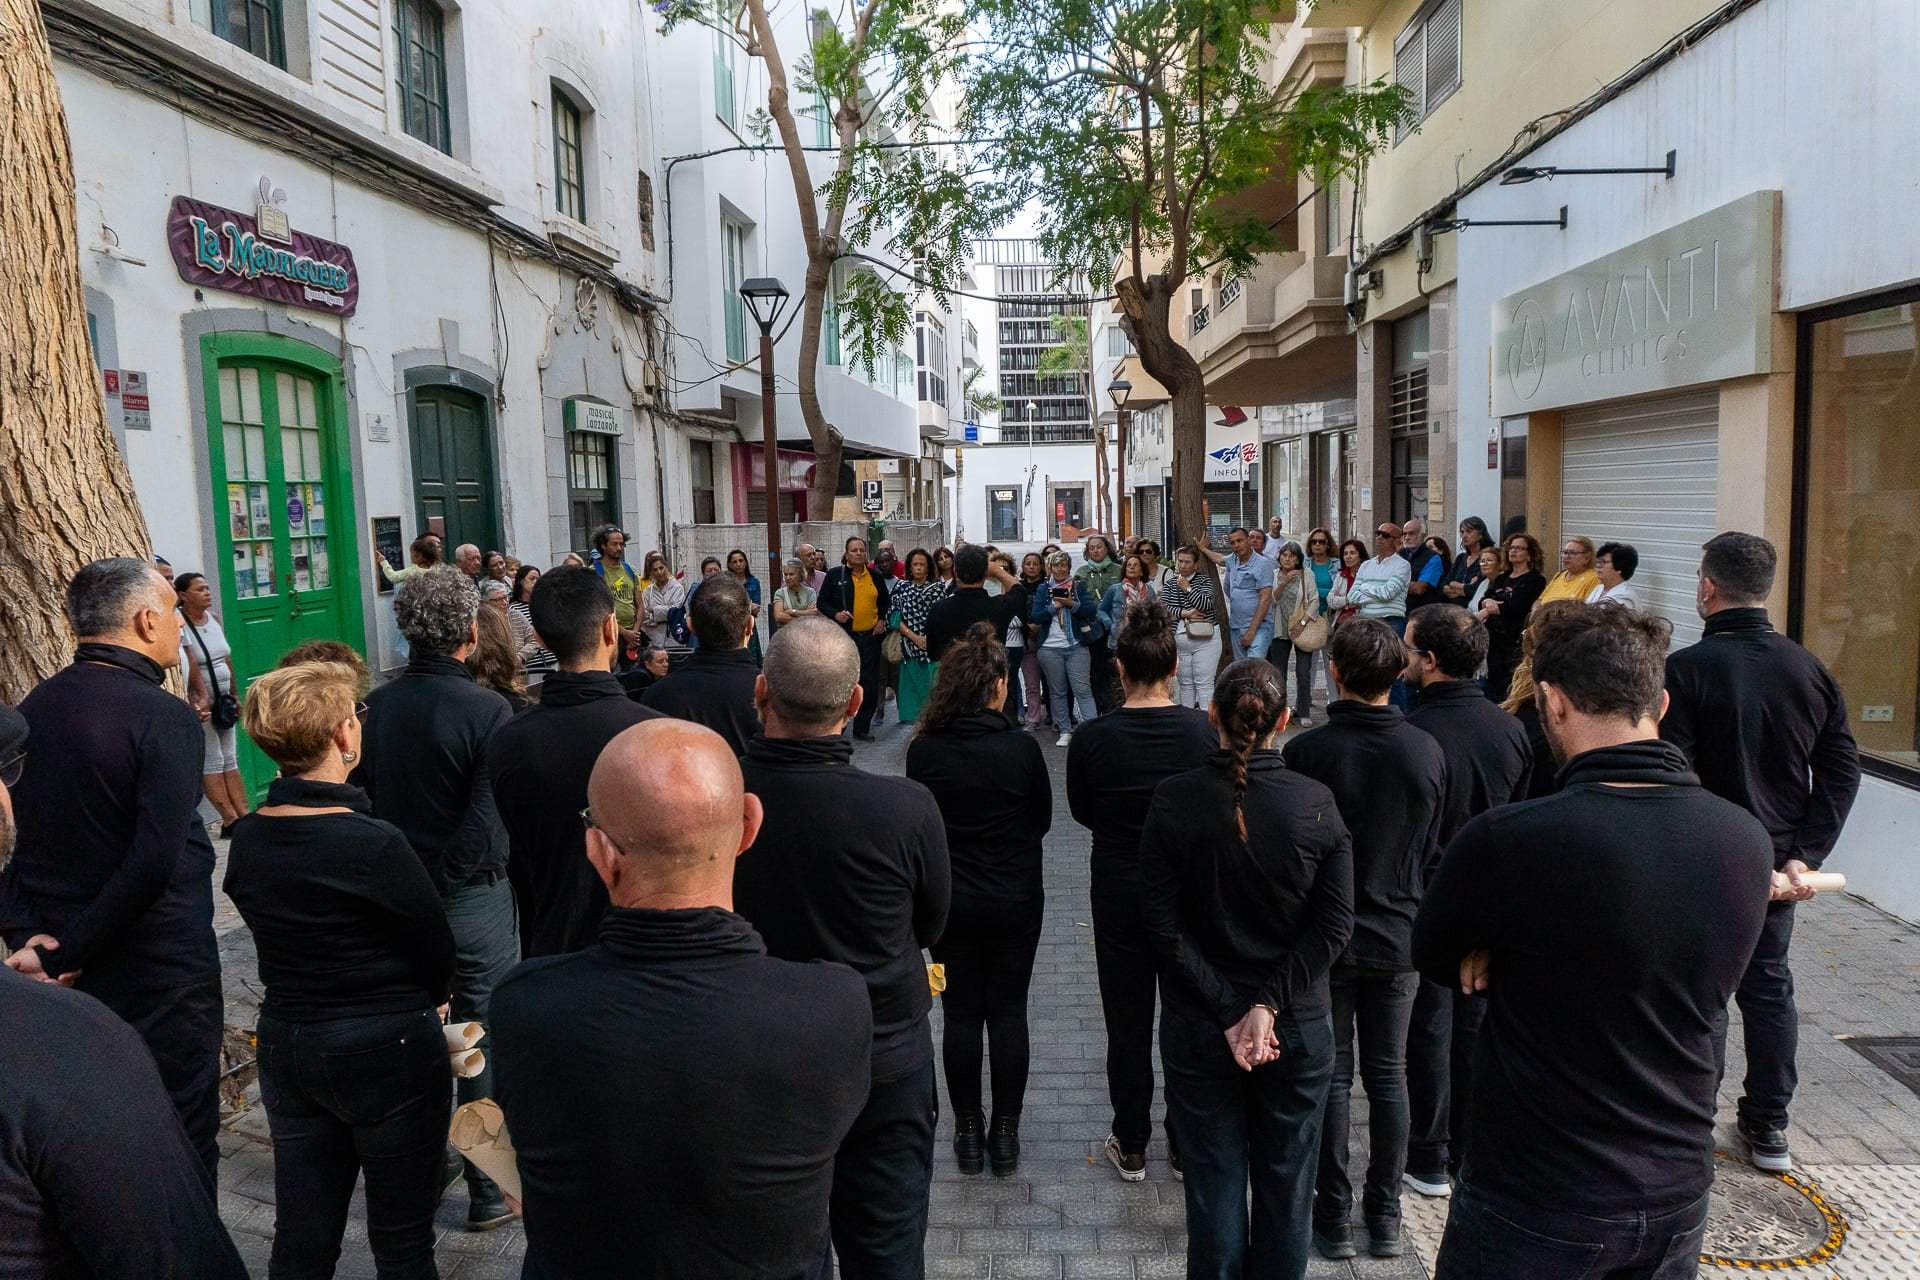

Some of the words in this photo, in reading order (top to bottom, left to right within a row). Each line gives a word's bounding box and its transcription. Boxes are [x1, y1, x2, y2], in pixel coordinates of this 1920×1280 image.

[192, 217, 225, 272] La
[1562, 240, 1720, 353] AVANTI
[1580, 329, 1689, 377] CLINICS
[867, 481, 878, 499] P
